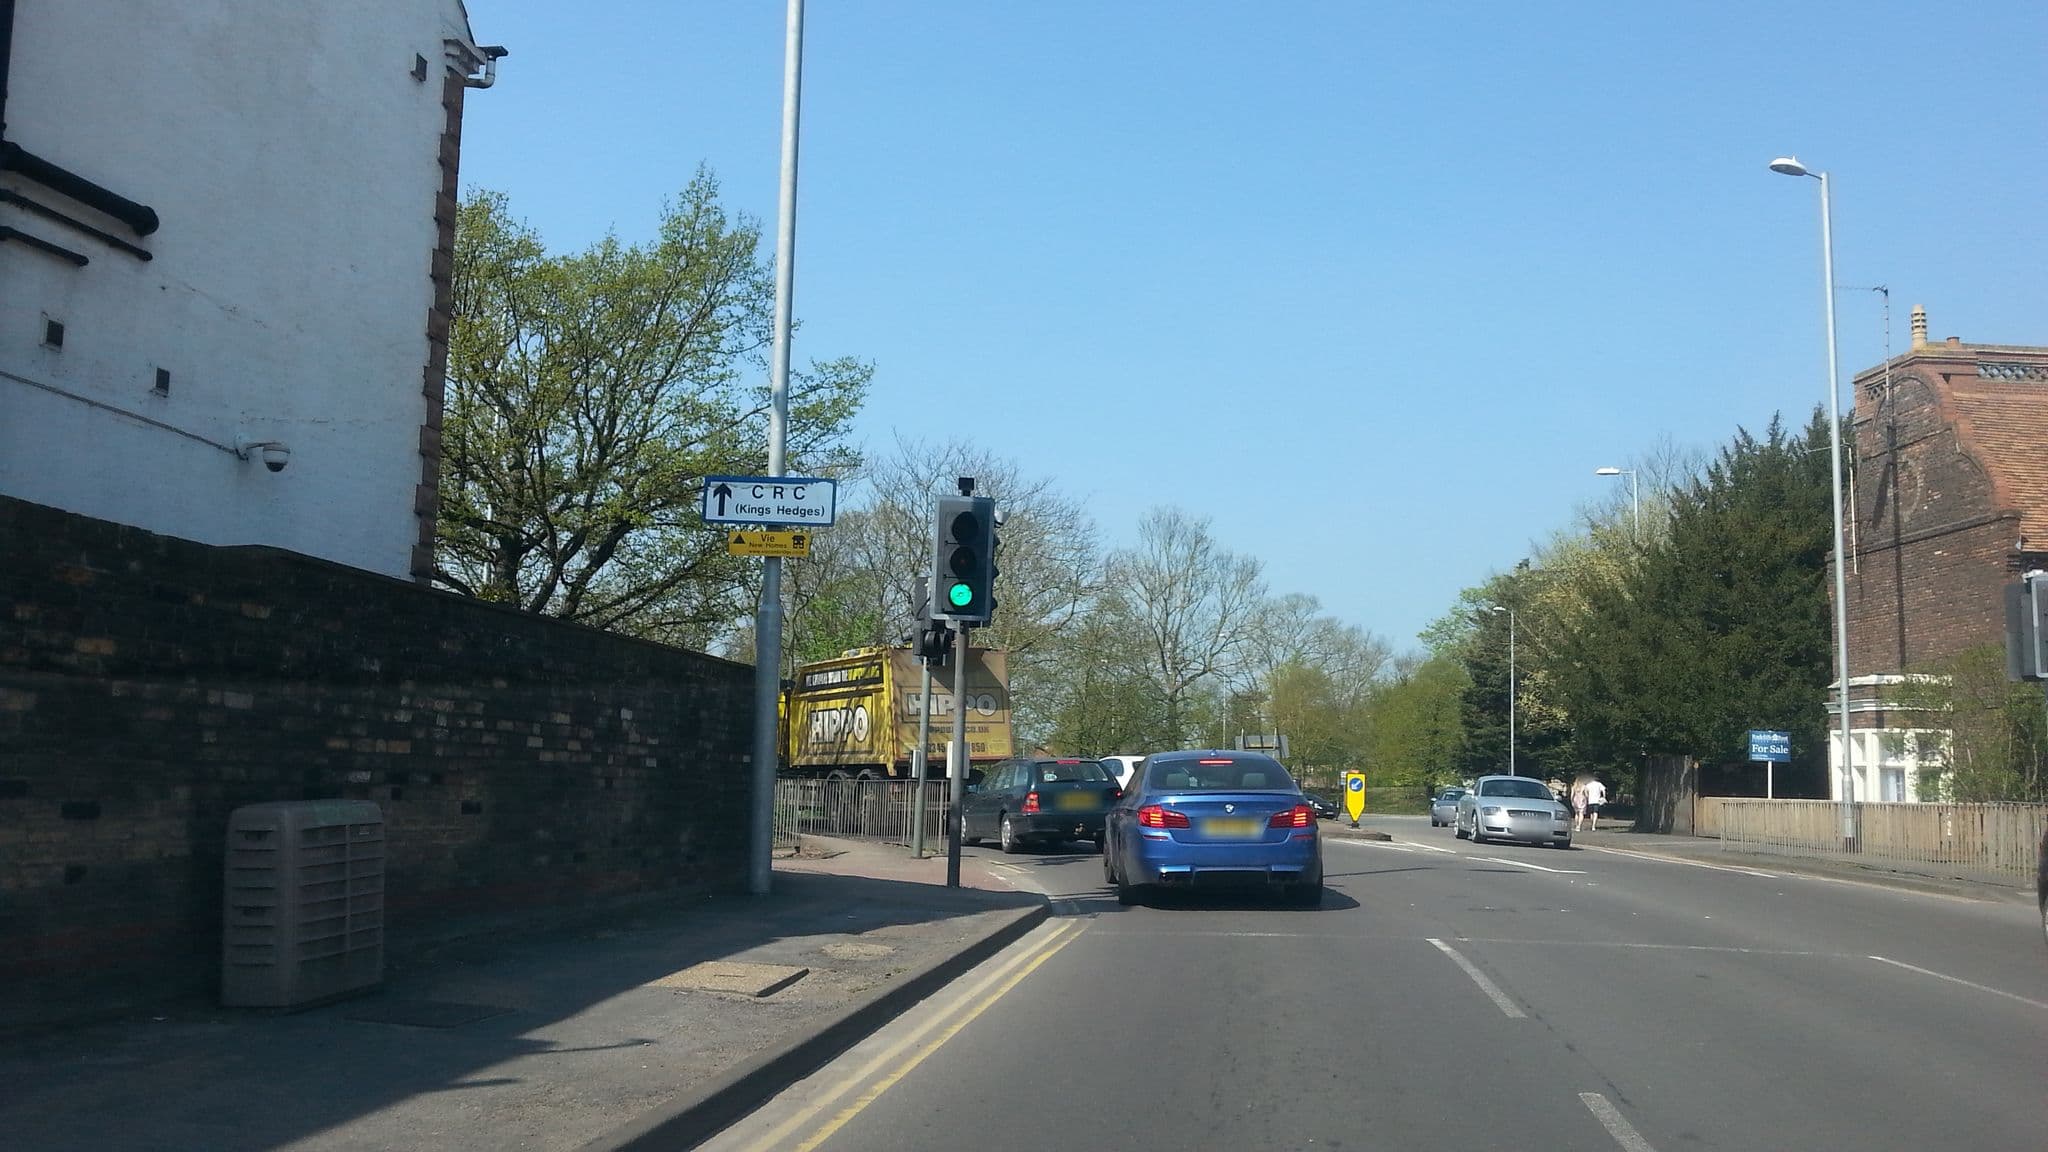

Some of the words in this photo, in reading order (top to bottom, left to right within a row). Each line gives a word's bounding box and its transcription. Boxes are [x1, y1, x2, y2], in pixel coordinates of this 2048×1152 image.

[735, 503, 771, 516] (Kings
[776, 504, 825, 518] Hedges)
[761, 534, 775, 542] Vie
[810, 705, 869, 743] HIPPO
[1752, 744, 1768, 753] For
[1770, 744, 1789, 754] Sale
